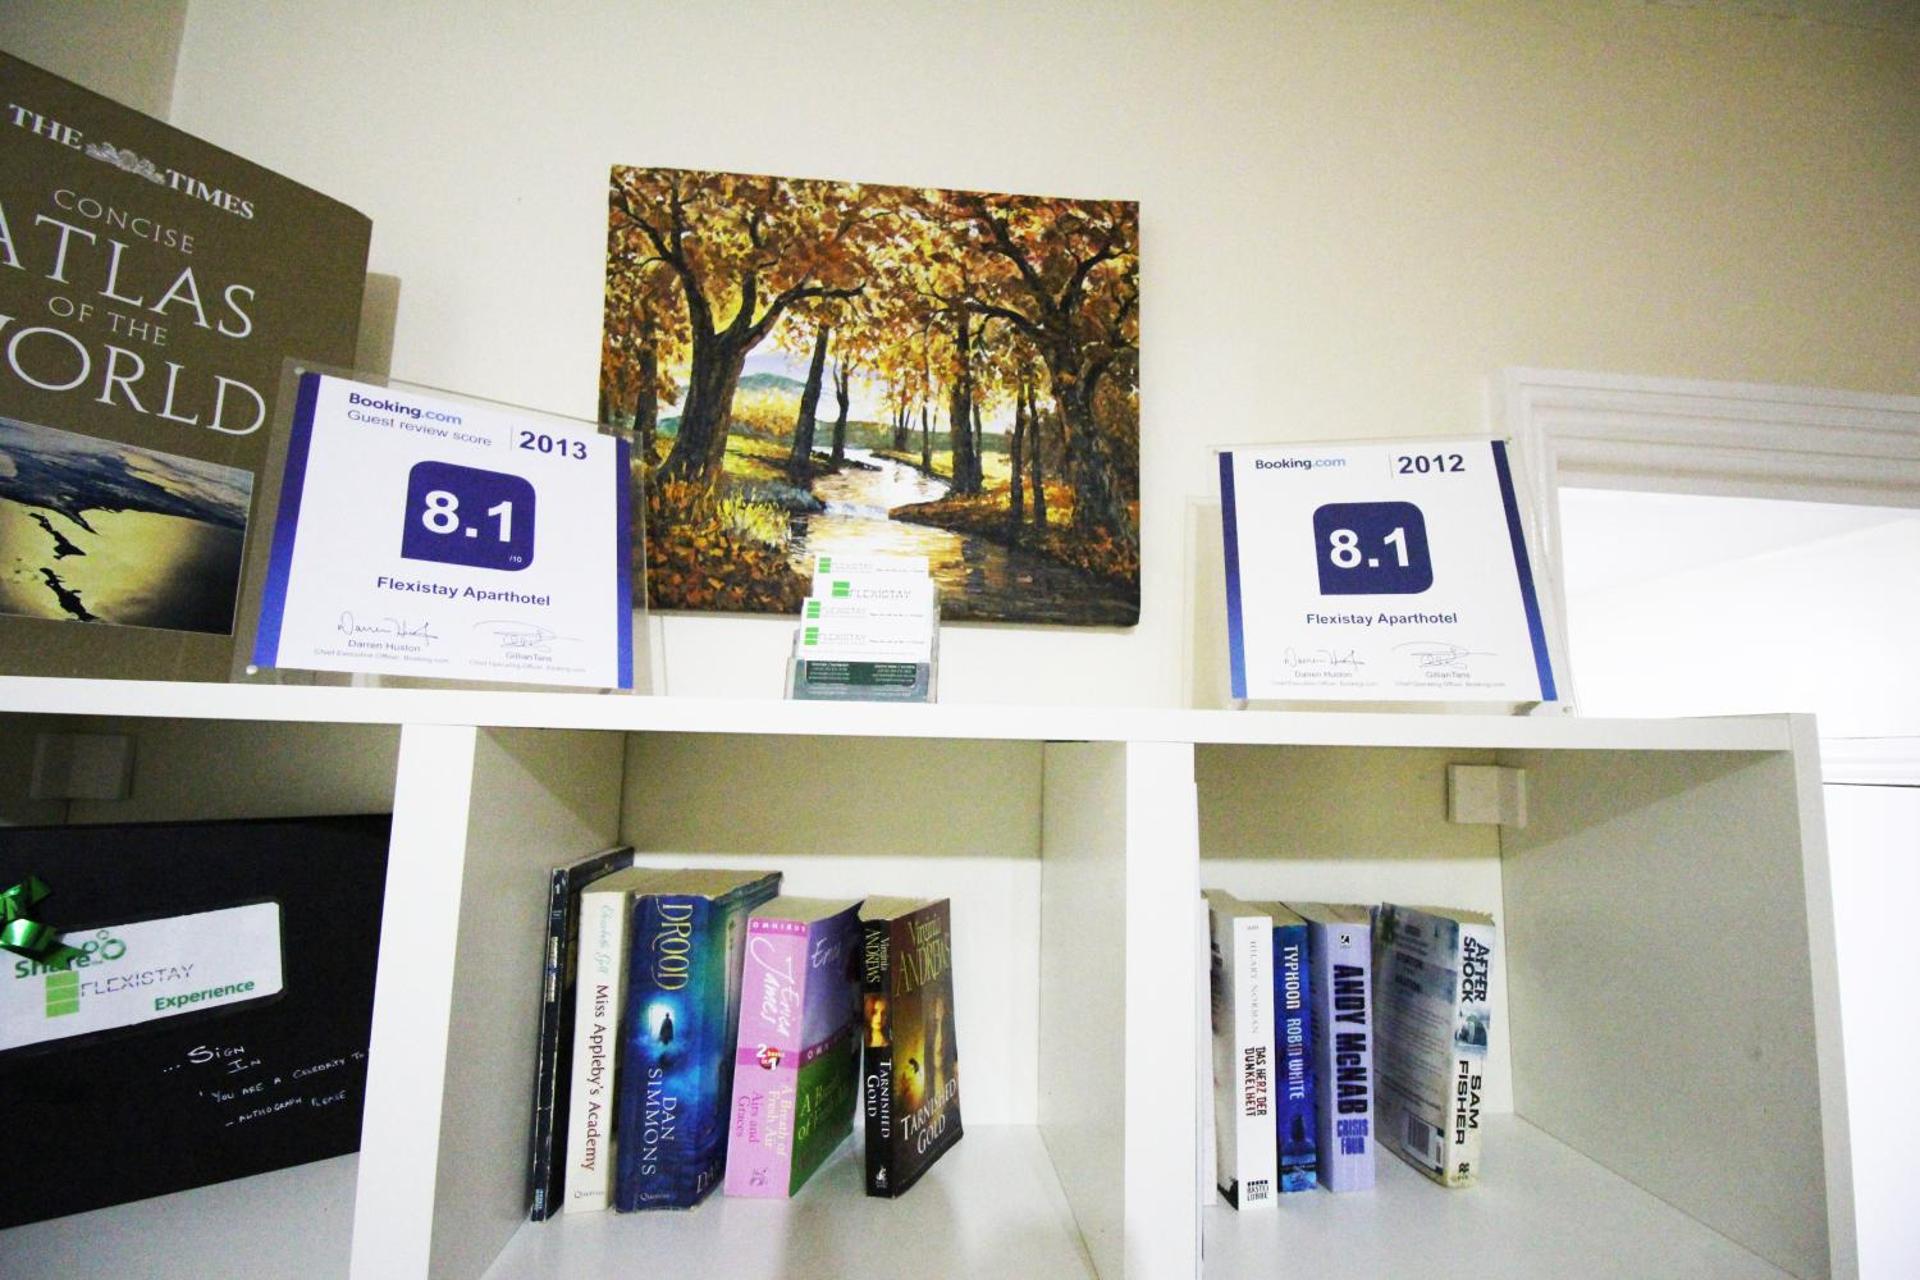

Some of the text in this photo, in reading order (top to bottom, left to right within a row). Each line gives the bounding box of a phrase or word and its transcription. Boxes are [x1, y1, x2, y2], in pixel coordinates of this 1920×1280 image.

[9, 103, 255, 220] THE TIMES
[54, 189, 195, 255] CONCISE
[48, 295, 169, 347] OF THE
[0, 314, 266, 436] ORLD
[347, 409, 493, 448] Guest review score
[349, 392, 462, 425] Booking.com
[518, 430, 588, 461] 2013
[1254, 456, 1346, 470] Booking.com
[1397, 454, 1466, 475] 2012
[421, 489, 514, 543] 8.1
[1329, 527, 1410, 569] 8.1
[376, 575, 551, 606] Flexistay Aparthotel
[1306, 612, 1458, 627] Flexistay Aparthotel
[15, 953, 90, 979] Shre
[650, 899, 693, 992] DROOD
[865, 928, 880, 983] ANDREWS
[1462, 936, 1477, 1004] SHOCK
[80, 963, 195, 998] FLEXISTAY
[154, 980, 256, 1012] Experience
[1333, 965, 1366, 1025] ANDY
[1474, 943, 1490, 1002] AFTER
[1283, 944, 1305, 1101] TYPHOON ROBIN WHITE
[756, 1044, 767, 1058] 2
[242, 1082, 265, 1096] ARE
[580, 984, 609, 1172] Miss Appleby's Academy
[867, 1074, 880, 1117] GOLD
[880, 1058, 892, 1139] TARNISHED
[1245, 1048, 1256, 1116] DUNKELHEIT
[1255, 1046, 1267, 1116] DAS HERZ DER
[1455, 1060, 1470, 1145] FISHER
[1468, 1075, 1482, 1129] SAM
[641, 1068, 663, 1177] SIMMONS
[661, 1096, 677, 1141] DAN
[917, 1114, 946, 1154] GOLD
